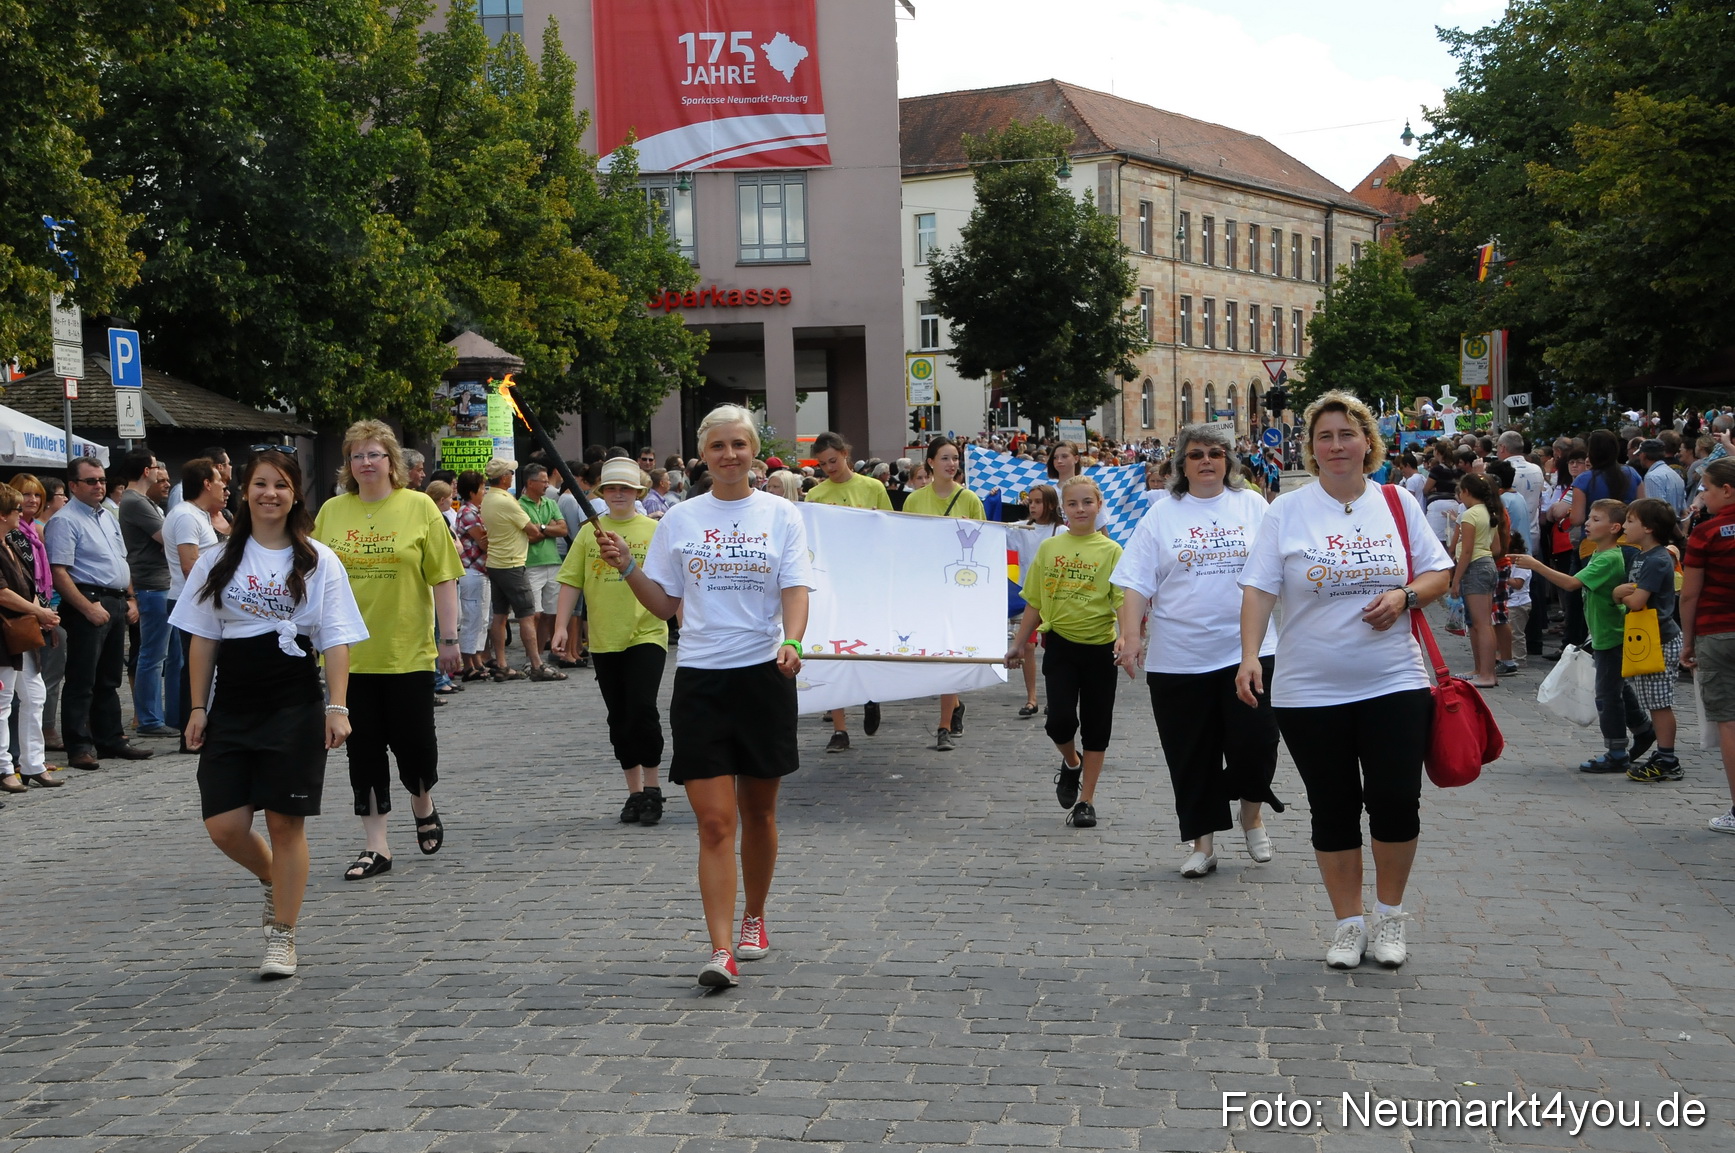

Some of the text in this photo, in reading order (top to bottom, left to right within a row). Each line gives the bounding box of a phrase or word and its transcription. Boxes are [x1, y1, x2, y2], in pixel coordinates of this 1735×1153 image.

[678, 31, 755, 64] 175
[681, 65, 756, 85] JAHRE
[681, 94, 808, 106] Sparkasse Neumarkt-Parsberg
[116, 336, 134, 380] P
[1511, 395, 1527, 406] WC
[23, 432, 57, 452] Winkler
[442, 447, 492, 455] VOLKSFEST
[345, 529, 392, 543] Kinder
[703, 528, 763, 543] Kinder
[1188, 527, 1239, 539] Kinder
[362, 543, 394, 554] Turn
[1209, 537, 1246, 548] Turn
[1325, 534, 1387, 550] Kinder
[694, 550, 711, 558] 2012
[725, 544, 767, 560] Turn
[1351, 549, 1397, 564] Turn
[688, 557, 772, 575] Olympiade
[1054, 555, 1094, 570] Kinder
[1317, 557, 1336, 566] 2012
[1067, 568, 1095, 582] Turn
[1306, 563, 1405, 583] Olympiade
[1329, 588, 1371, 597] Neumarkt
